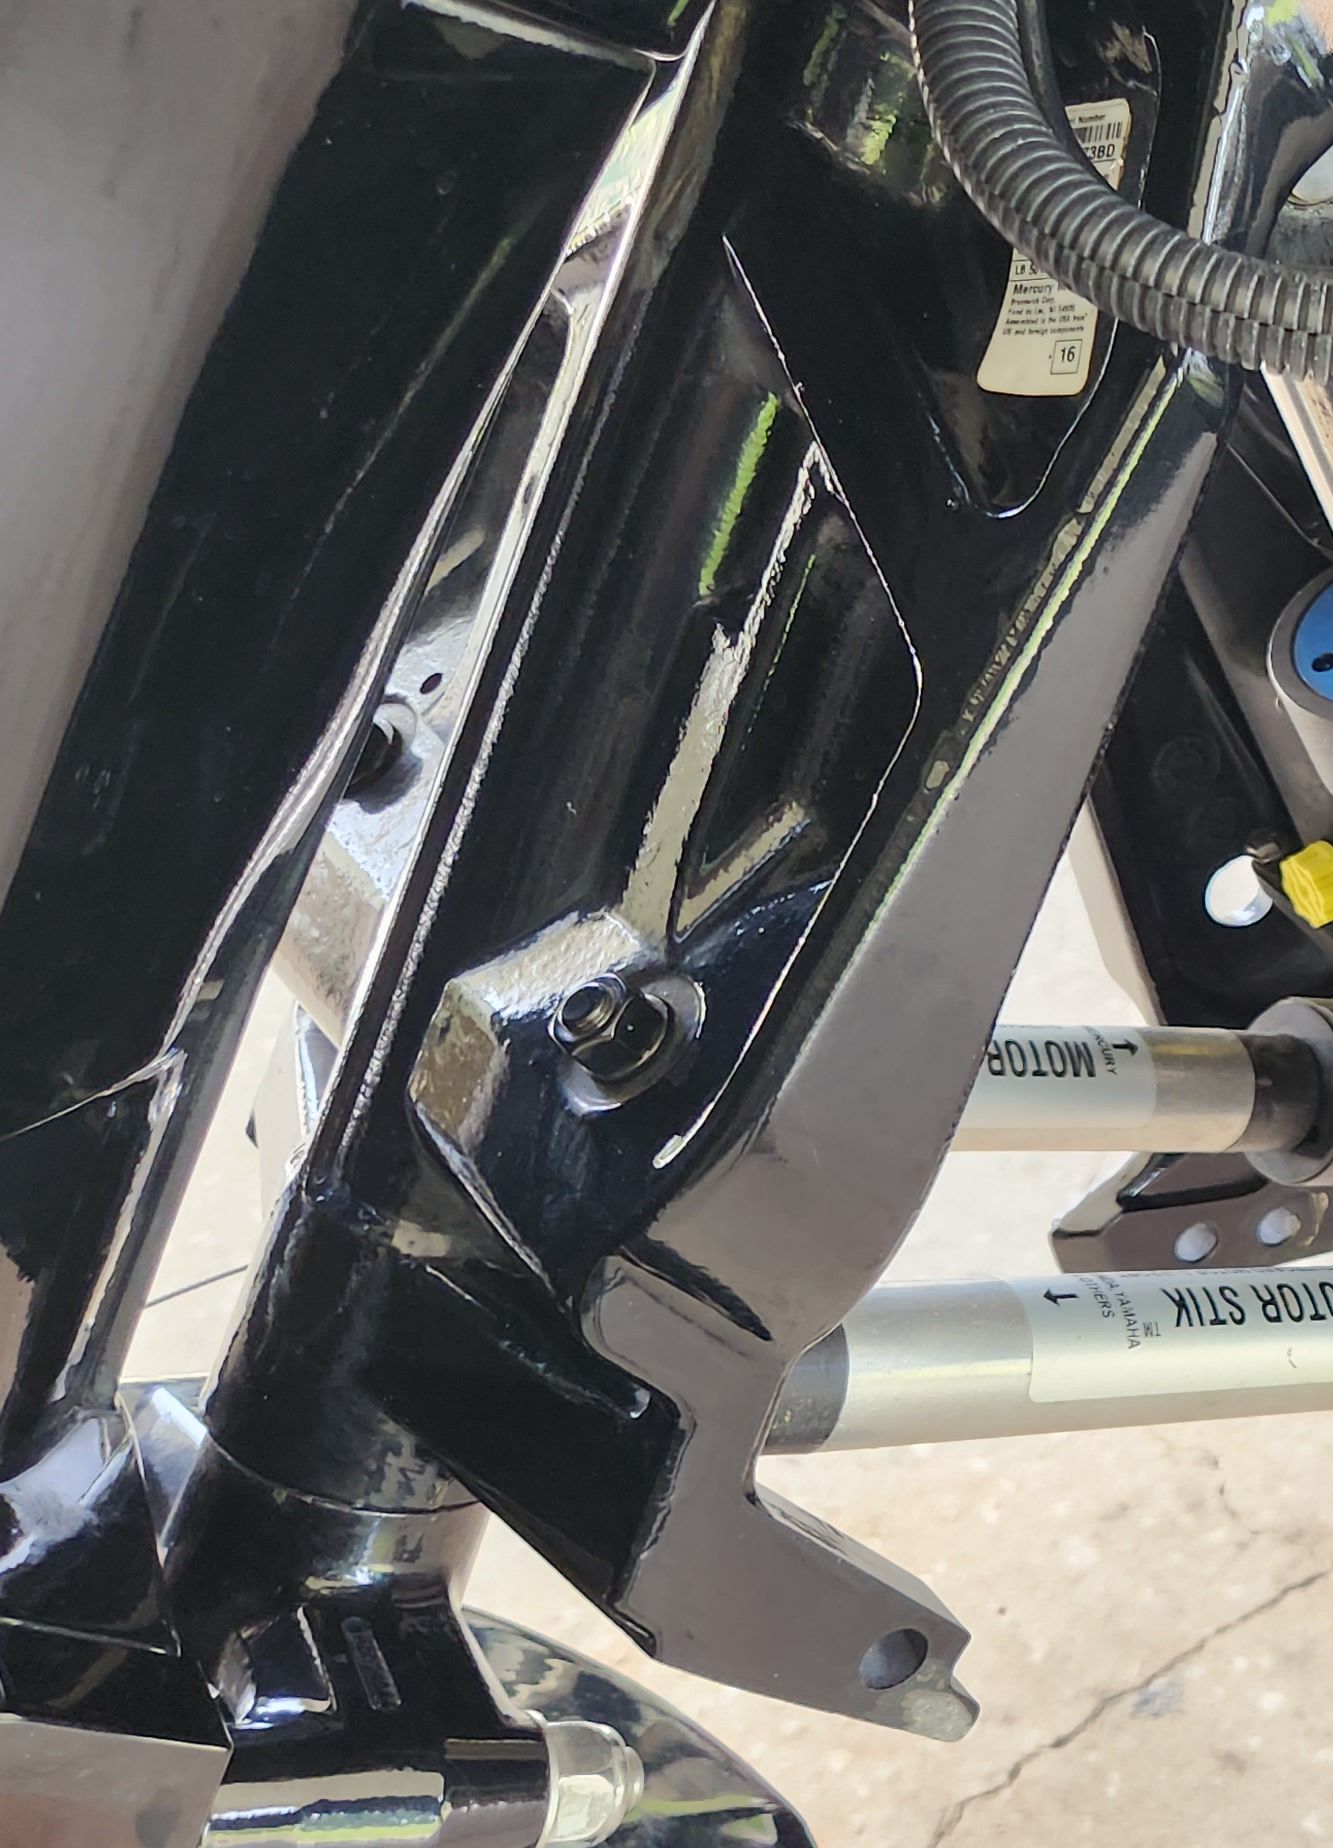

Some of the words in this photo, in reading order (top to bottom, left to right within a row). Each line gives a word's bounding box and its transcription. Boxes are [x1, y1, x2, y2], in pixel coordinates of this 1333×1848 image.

[1013, 284, 1053, 297] Mercury
[1060, 346, 1076, 363] 16
[987, 1039, 1097, 1077] MOTOR
[1114, 1291, 1142, 1350] YAMAHA
[1161, 1284, 1247, 1328] STIK
